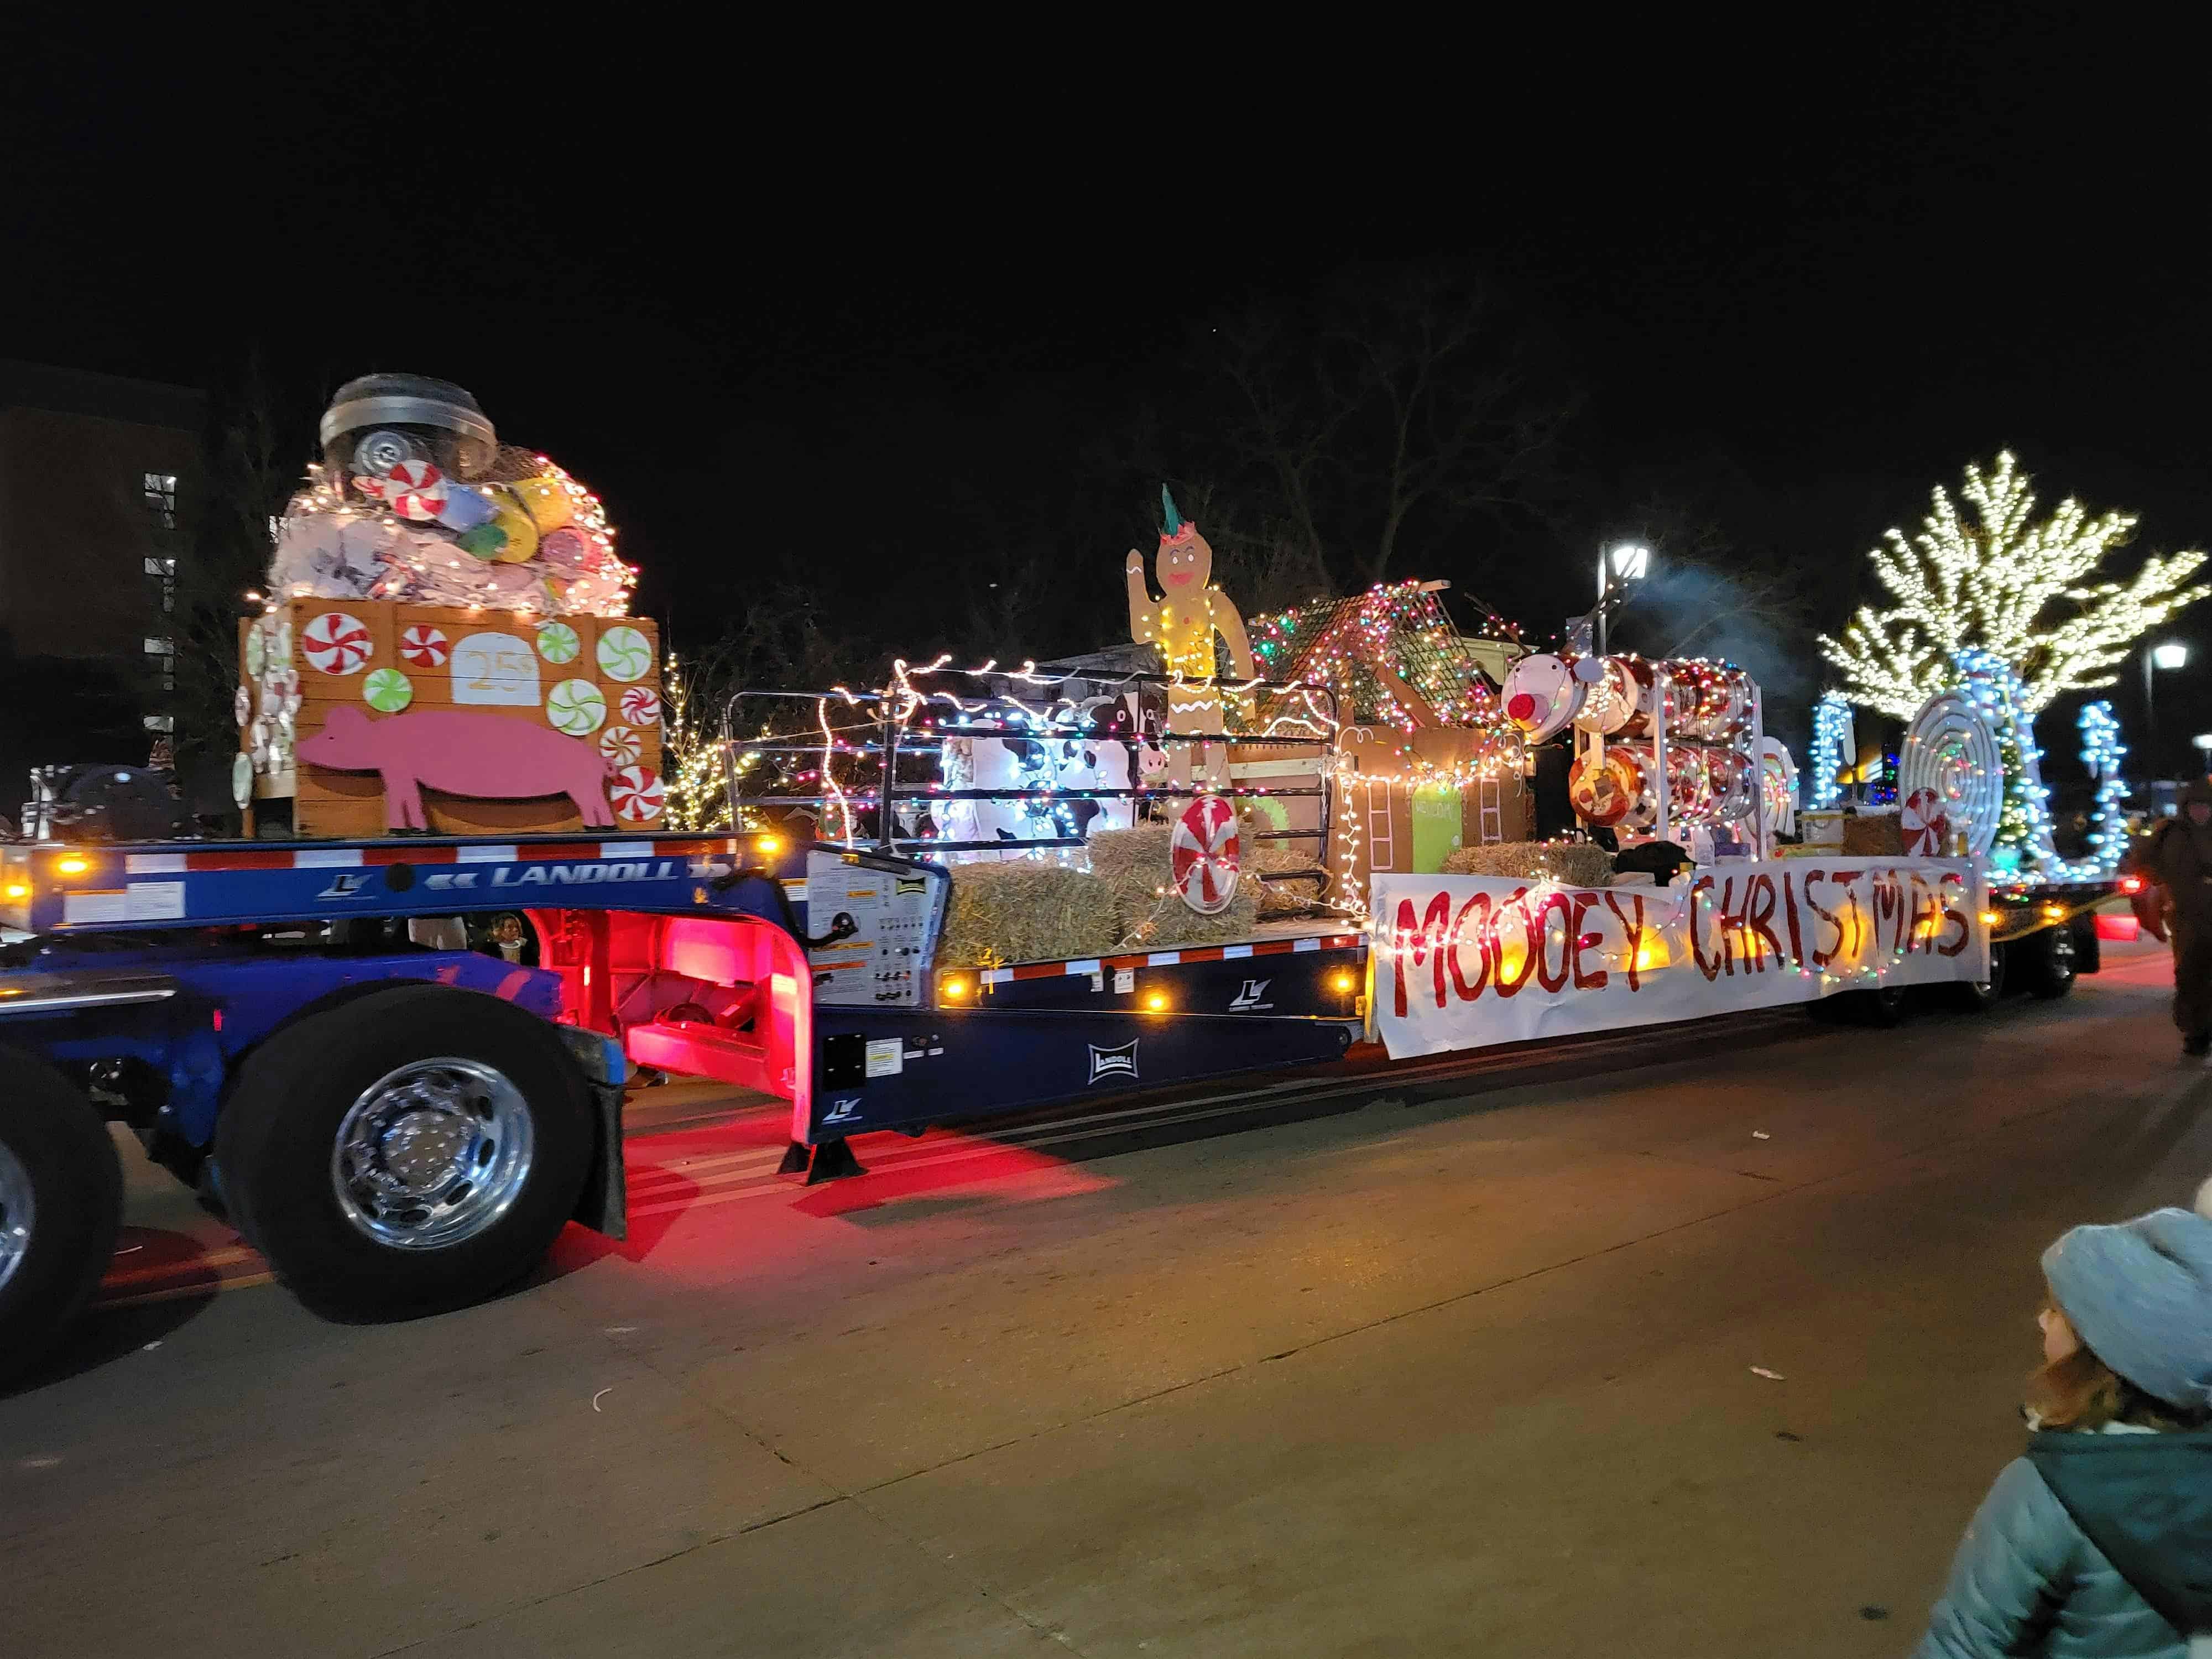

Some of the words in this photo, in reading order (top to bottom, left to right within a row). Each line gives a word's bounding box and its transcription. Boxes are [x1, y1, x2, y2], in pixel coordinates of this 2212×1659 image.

[491, 862, 679, 888] LANDOLL
[1394, 885, 1644, 1018] MOOOEY
[1690, 869, 1970, 982] CHRISTMAS
